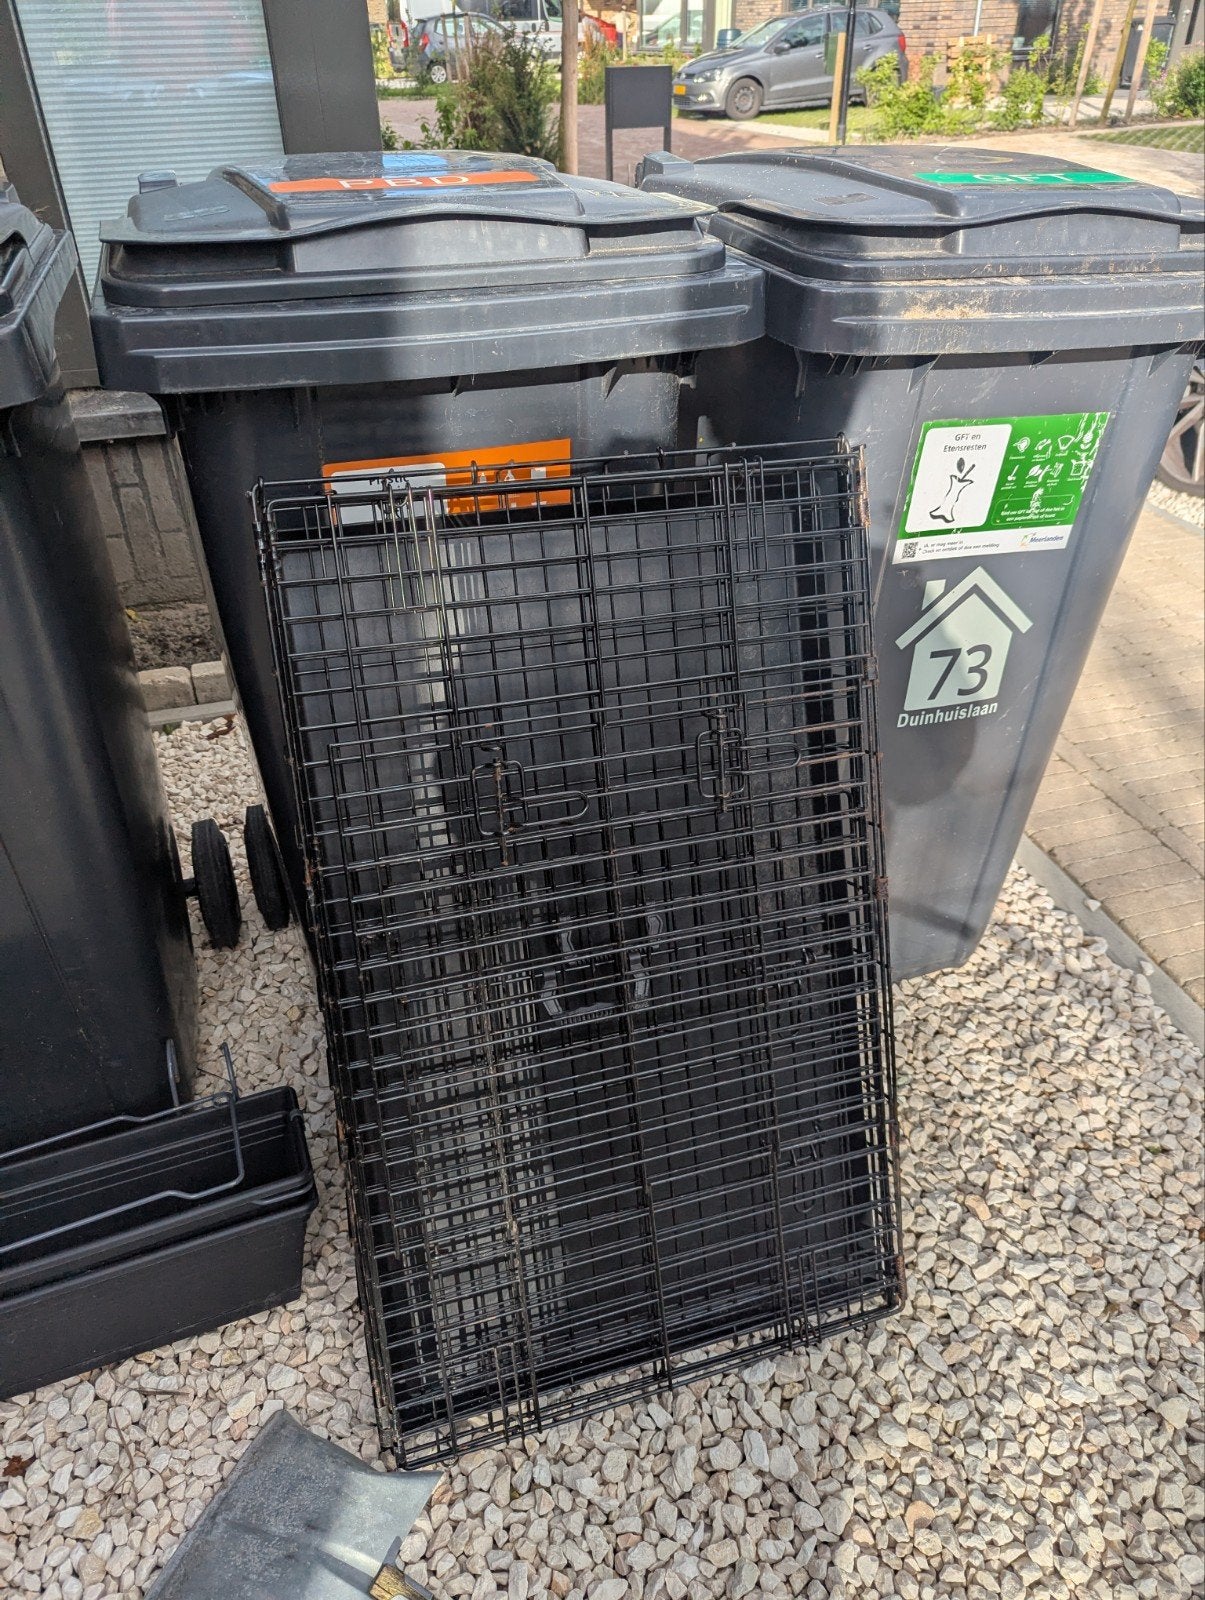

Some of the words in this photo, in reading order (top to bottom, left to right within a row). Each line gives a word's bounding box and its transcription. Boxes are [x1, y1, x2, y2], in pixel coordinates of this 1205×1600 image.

[338, 175, 469, 189] PBD
[972, 173, 1073, 182] GFT
[954, 433, 970, 441] GFT
[943, 443, 987, 453] Etensresten
[927, 644, 992, 700] 73
[896, 702, 998, 728] Duinhuislaan
